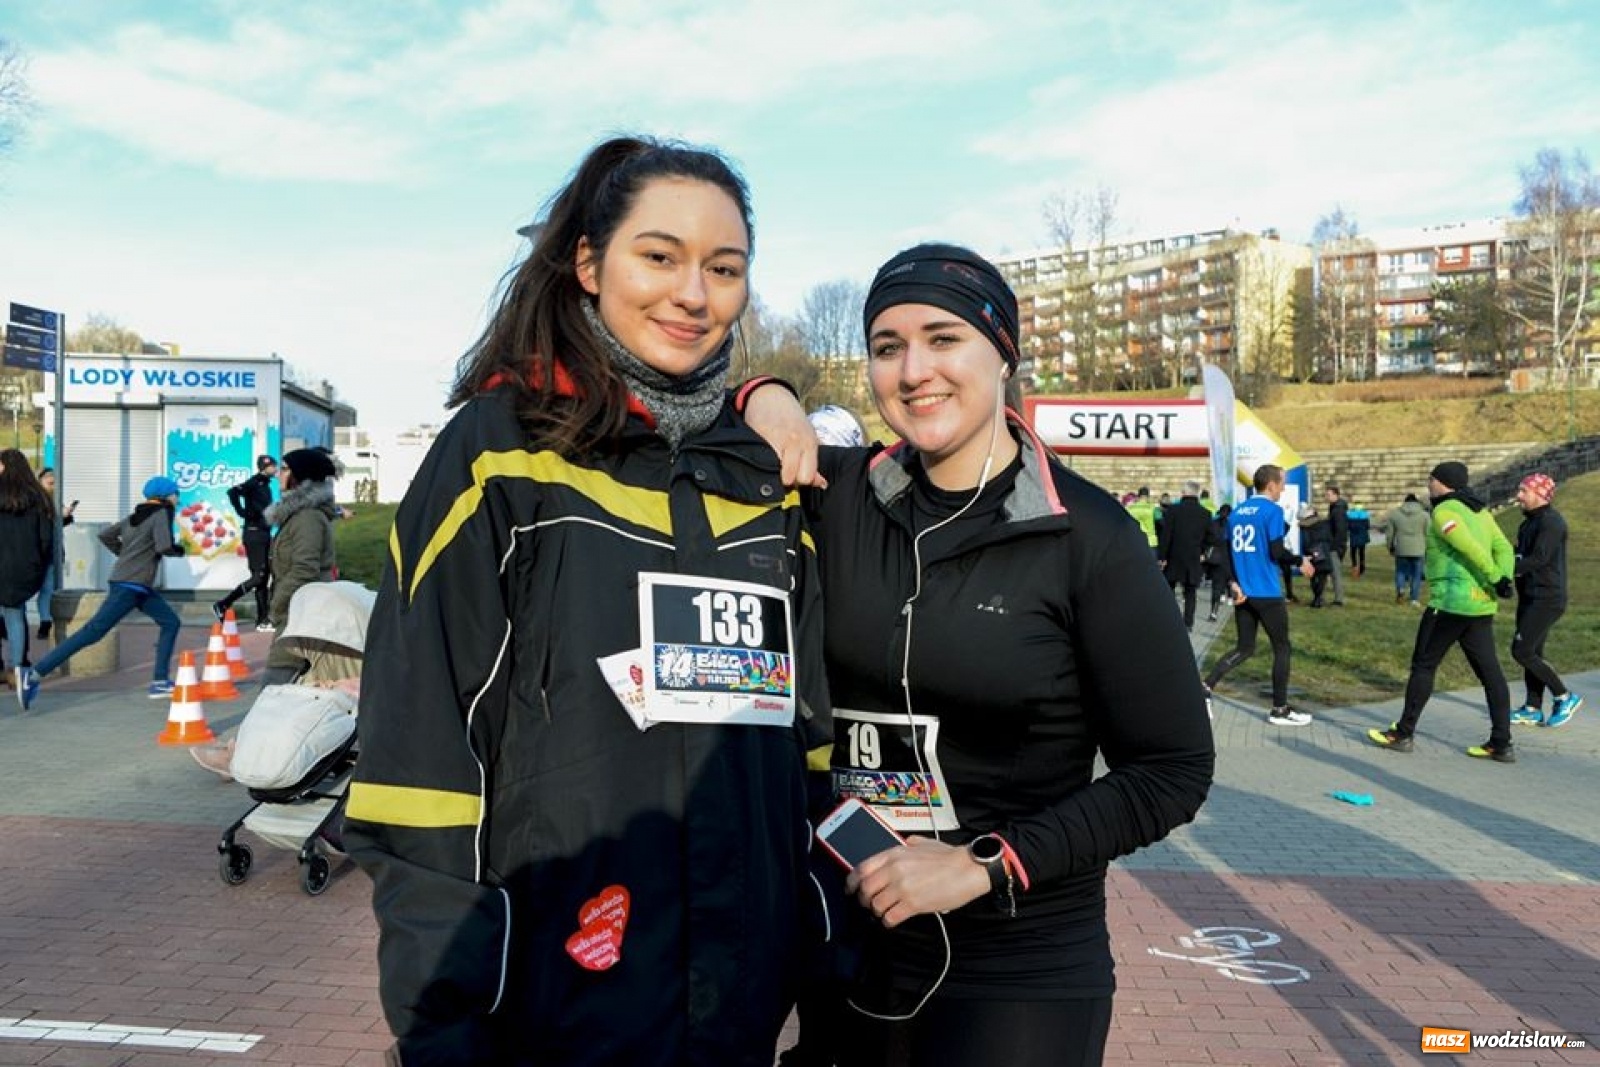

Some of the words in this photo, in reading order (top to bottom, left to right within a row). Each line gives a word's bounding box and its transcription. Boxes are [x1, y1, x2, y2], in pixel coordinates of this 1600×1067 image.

[70, 367, 134, 386] LODY
[143, 369, 256, 388] WŁOSKIE
[1068, 412, 1178, 440] START
[1232, 524, 1256, 553] 82
[692, 591, 764, 647] 133
[847, 722, 881, 769] 19
